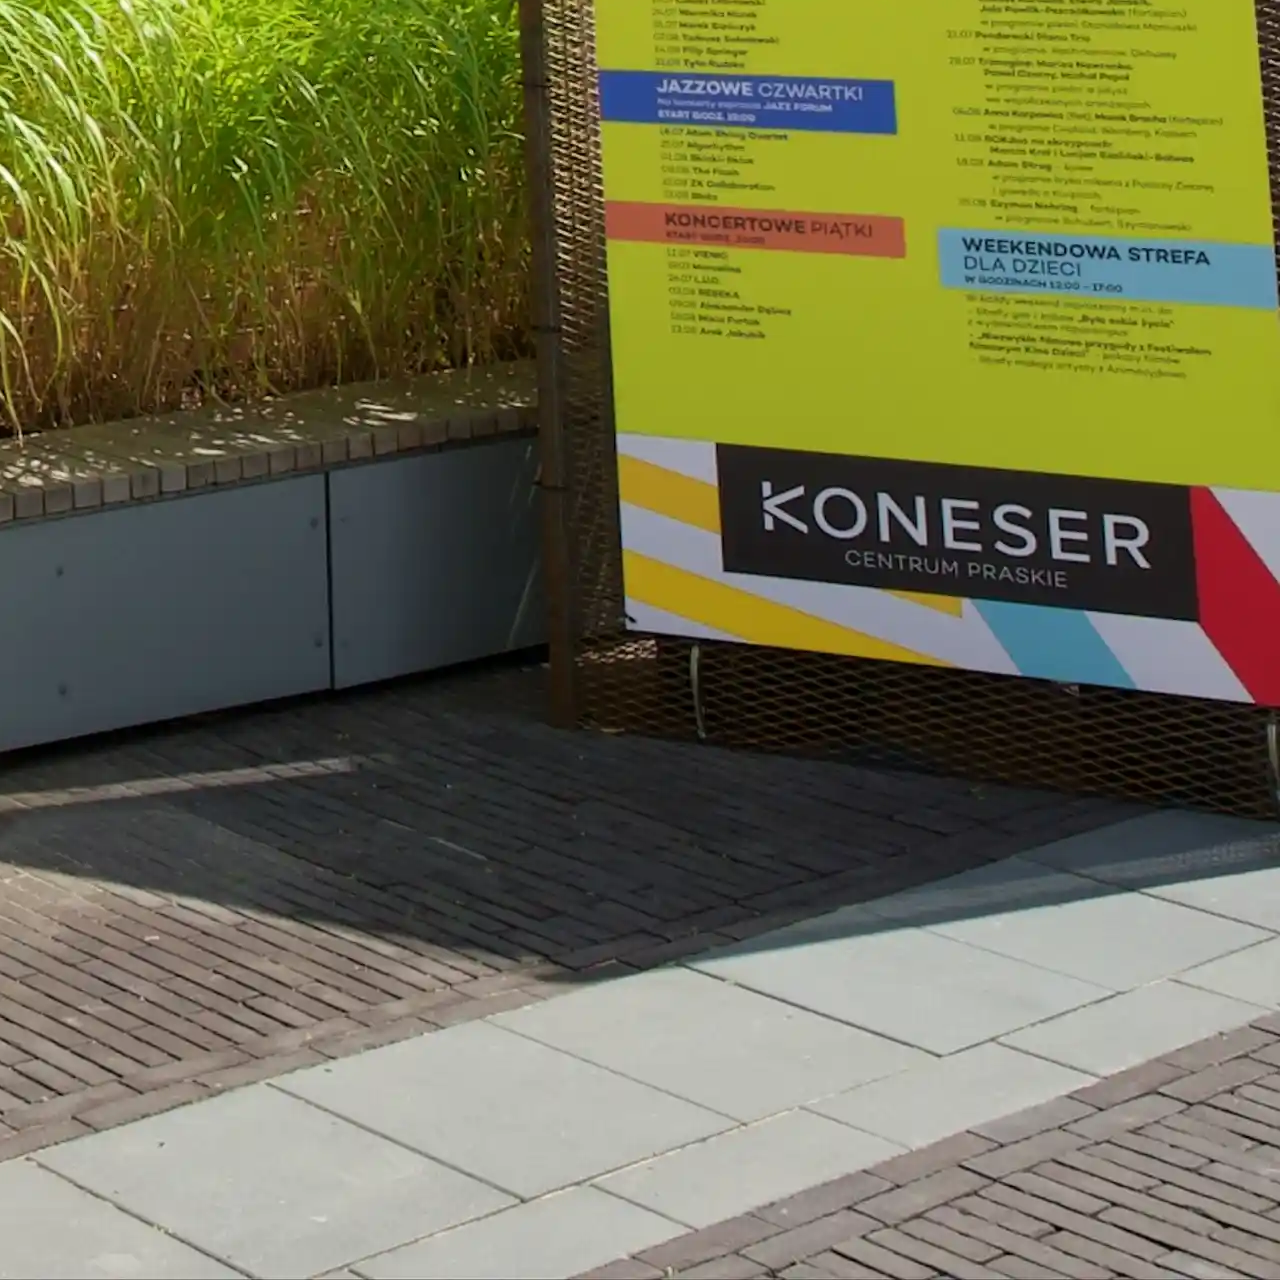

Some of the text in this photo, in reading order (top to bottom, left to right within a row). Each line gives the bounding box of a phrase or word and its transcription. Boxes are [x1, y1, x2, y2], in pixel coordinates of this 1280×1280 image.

[656, 79, 864, 101] JAZZOWE CZWARTKI
[664, 212, 874, 240] KONCERTOWE PIĄTKI
[961, 237, 1211, 266] WEEKENDOWA STREFA
[963, 255, 1082, 277] DLA DZIECI
[964, 275, 976, 284] W
[978, 276, 1048, 288] GODZINACH
[761, 480, 1152, 570] KONESER
[844, 549, 1069, 589] CENTRUM PRASKIE
